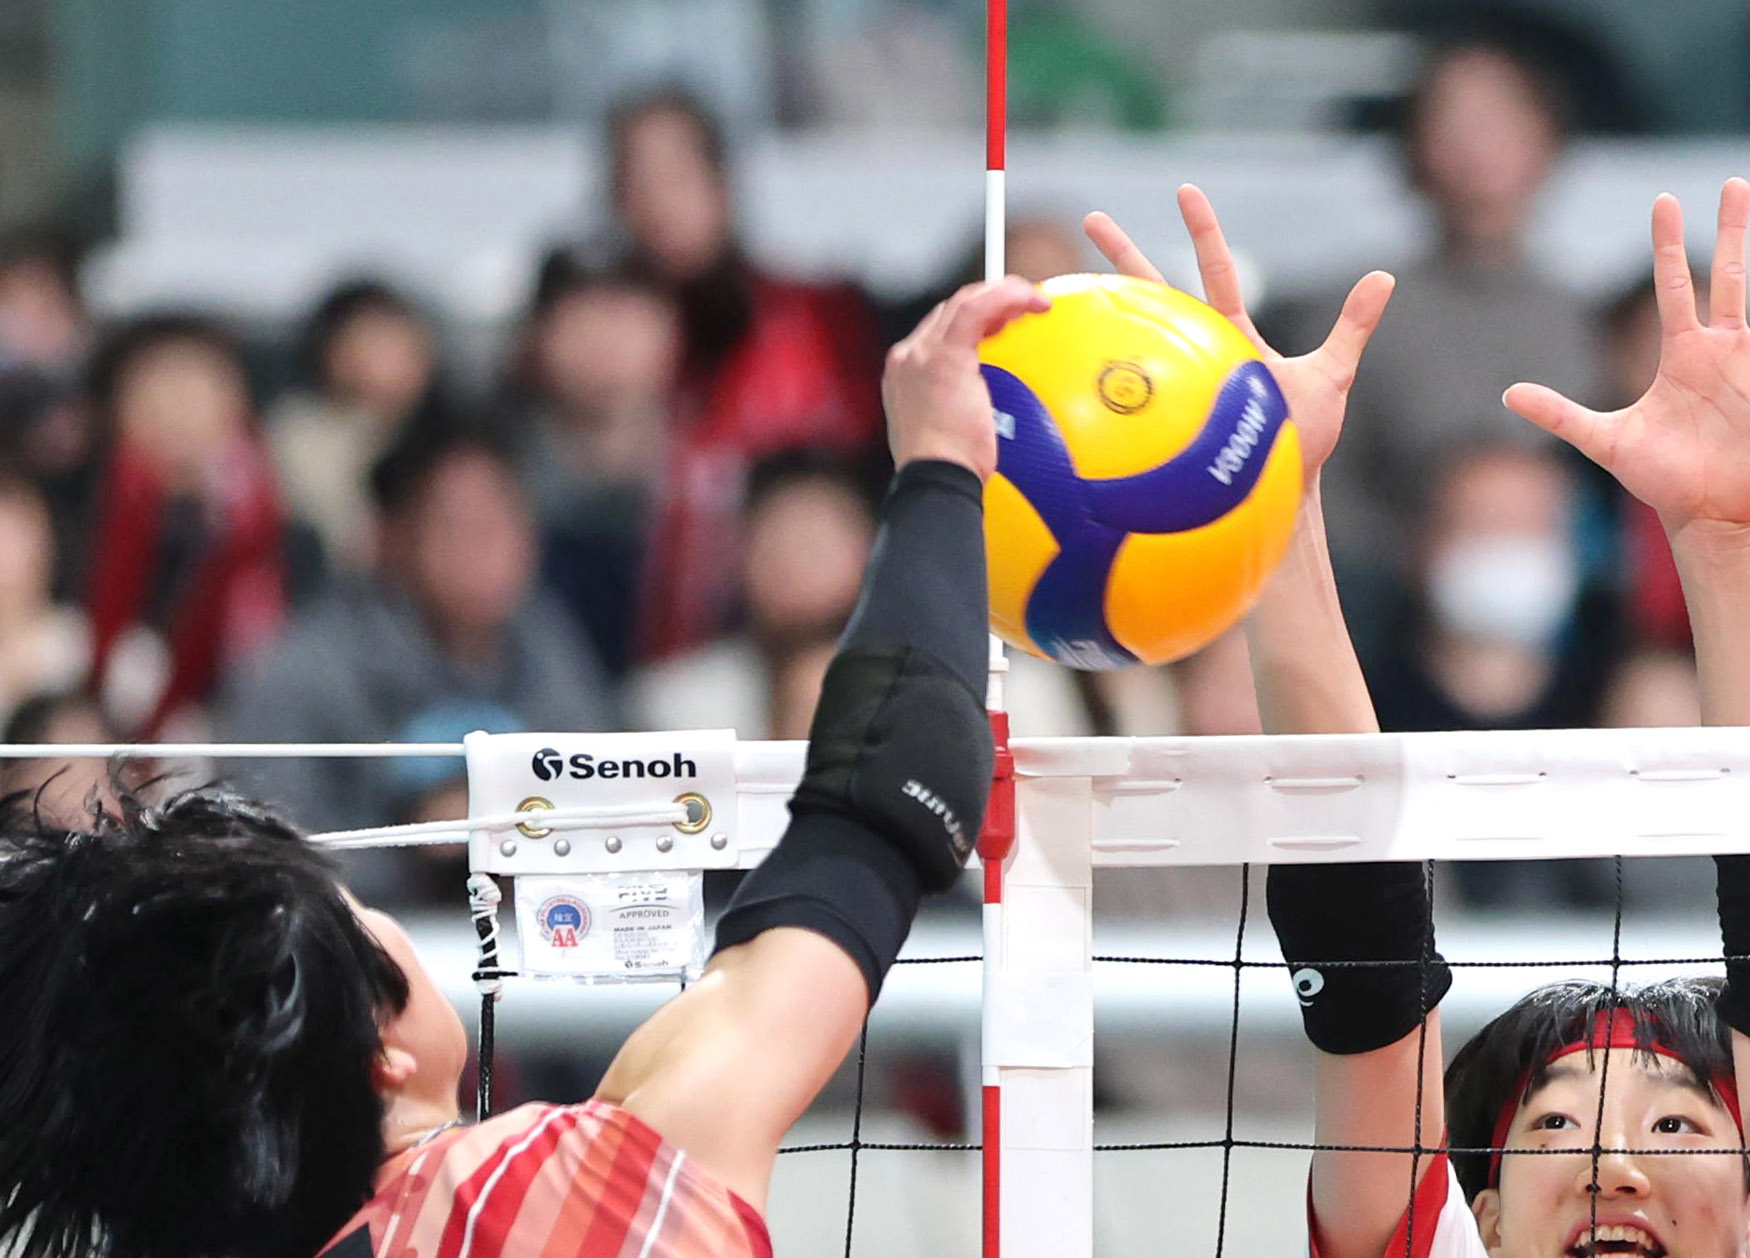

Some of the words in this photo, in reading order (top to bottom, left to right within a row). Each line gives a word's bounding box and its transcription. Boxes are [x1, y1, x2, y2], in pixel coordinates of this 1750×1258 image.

[569, 753, 697, 780] Senoh
[619, 910, 670, 919] APPROVED
[551, 927, 579, 948] AA
